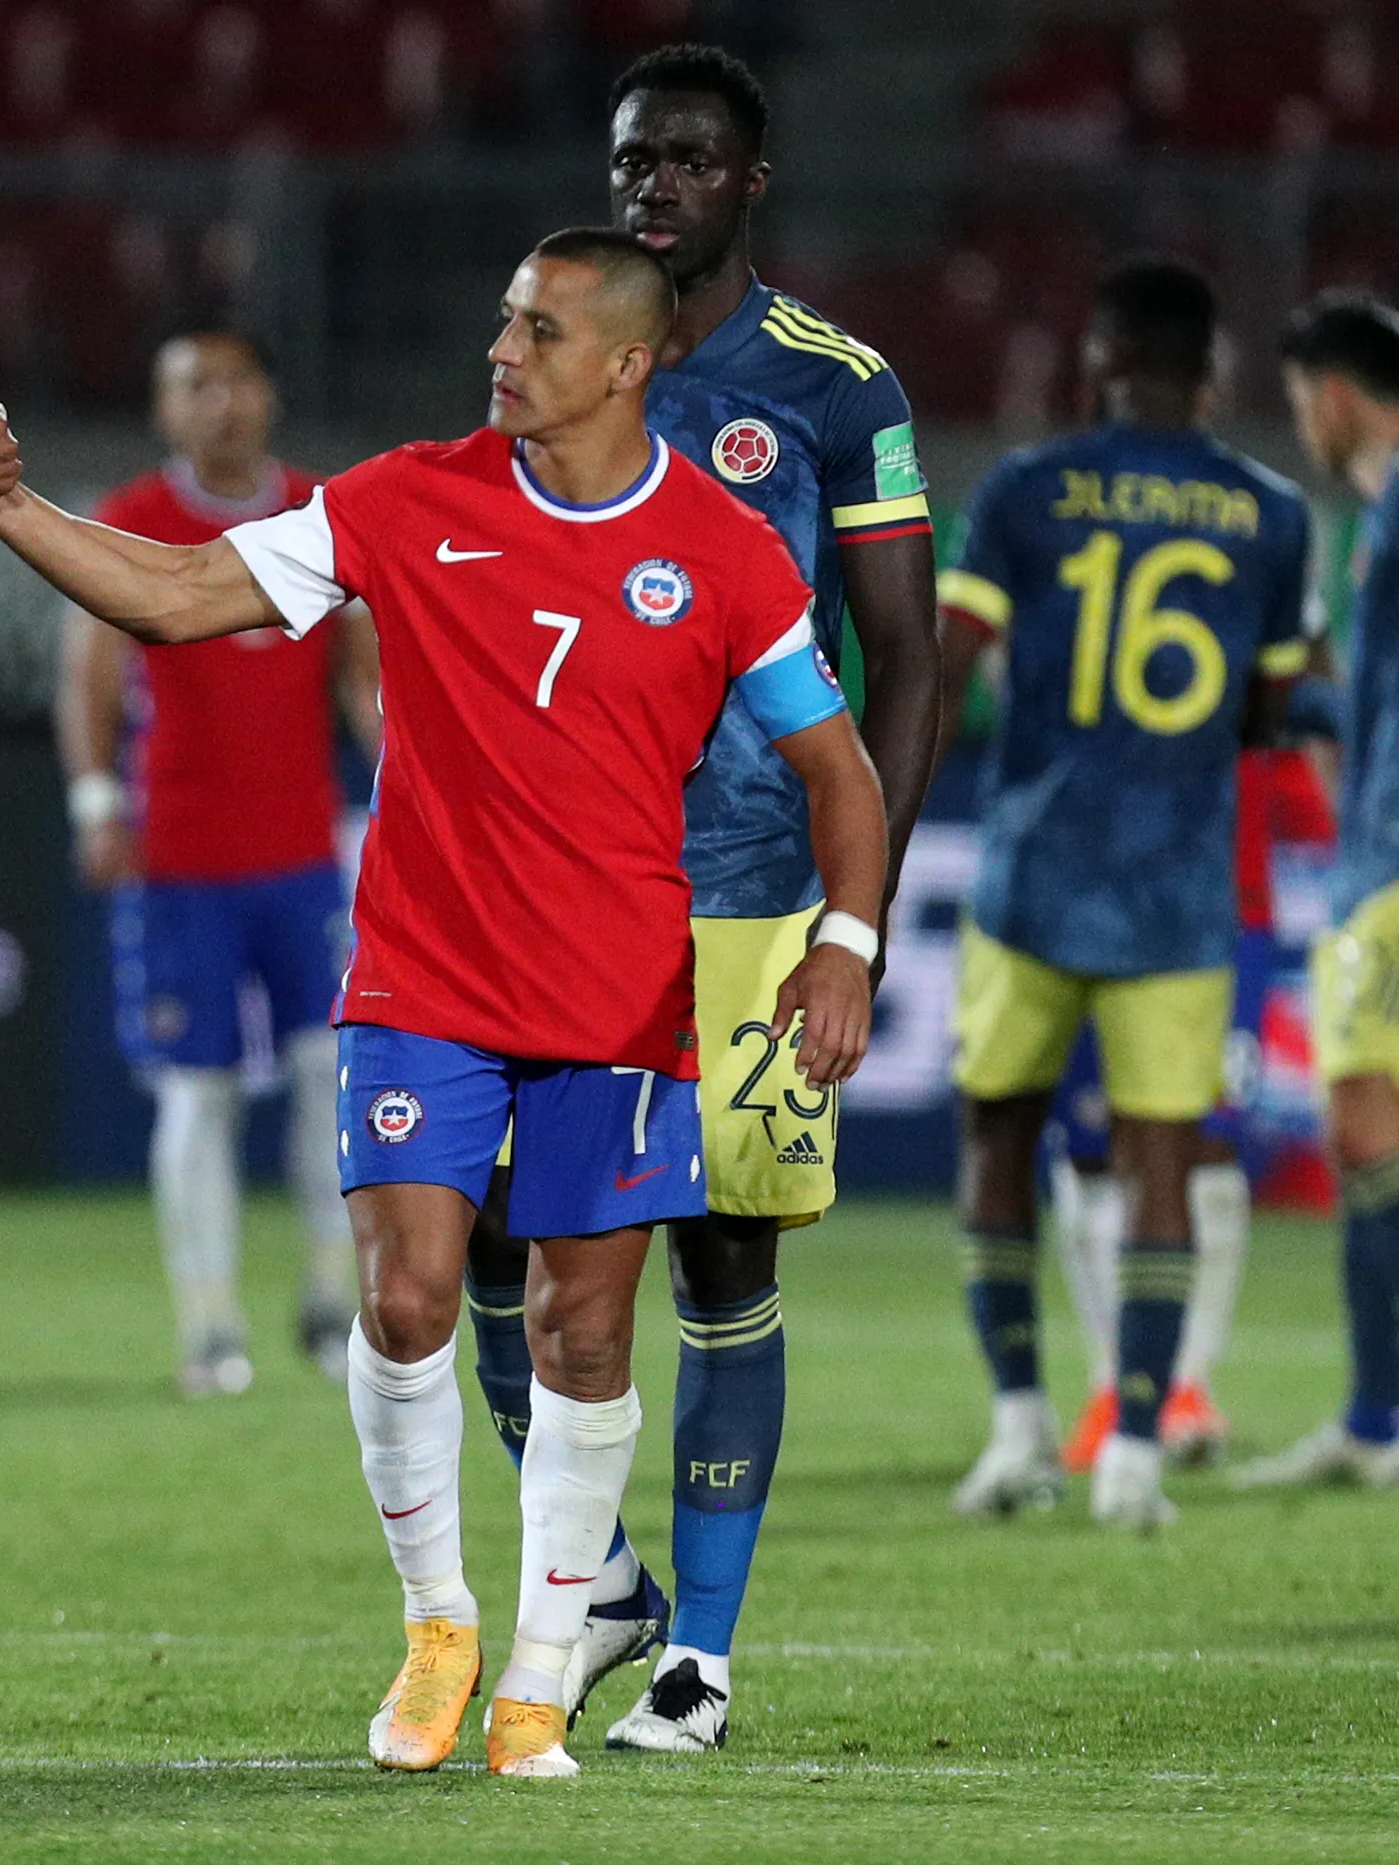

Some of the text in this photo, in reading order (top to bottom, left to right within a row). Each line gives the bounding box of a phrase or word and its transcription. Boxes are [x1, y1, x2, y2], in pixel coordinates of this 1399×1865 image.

[532, 610, 581, 709] 7
[1057, 530, 1236, 736] 16
[610, 1065, 657, 1156] 7
[776, 1152, 824, 1165] adidas
[493, 1410, 529, 1437] FC
[689, 1460, 751, 1488] FCF
